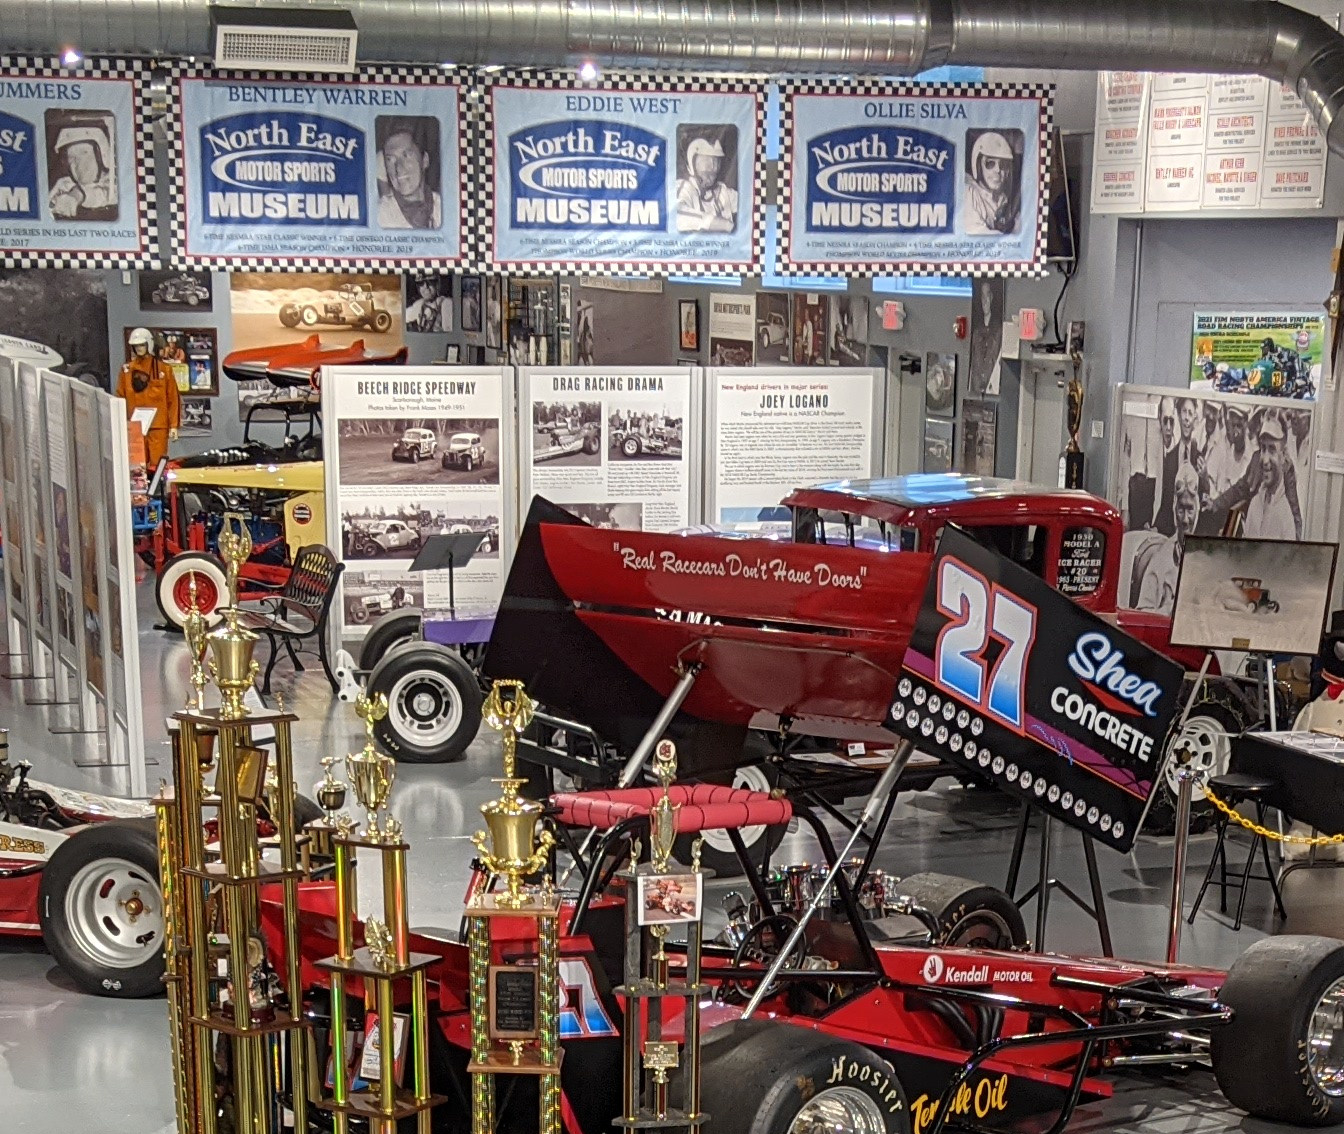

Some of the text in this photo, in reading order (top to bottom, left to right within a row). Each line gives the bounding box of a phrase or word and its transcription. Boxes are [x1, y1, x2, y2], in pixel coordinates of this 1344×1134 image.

[228, 86, 407, 106] BENTLEY WARREN
[566, 95, 681, 114] EDDIE WEST
[864, 102, 968, 119] OLLIE SILVA
[205, 121, 358, 159] North East
[513, 128, 660, 167] North East
[811, 134, 949, 172] North East
[235, 162, 335, 183] MOTOR SPORTS
[542, 168, 638, 189] MOTOR SPORTS
[837, 172, 927, 193] MOTOR SPORTS
[209, 192, 359, 220] MUSEUM
[516, 197, 659, 224] MUSEUM
[812, 202, 947, 227] MUSEUM
[357, 381, 477, 395] BEECH RIDGE SPEEDWAY
[552, 376, 664, 392] DRAG RACING DRAMA
[760, 395, 829, 408] JOEY LOGANO
[660, 551, 726, 577] Racecars
[725, 554, 768, 580] Don't
[769, 559, 812, 584] Have
[936, 554, 1038, 737] 27
[1067, 632, 1163, 717] Shea
[1050, 686, 1154, 763] CONCRETE
[945, 965, 1033, 983] Kendall MOTOR OIL
[826, 1055, 903, 1113] Hoosier
[975, 1073, 1008, 1118] Oil
